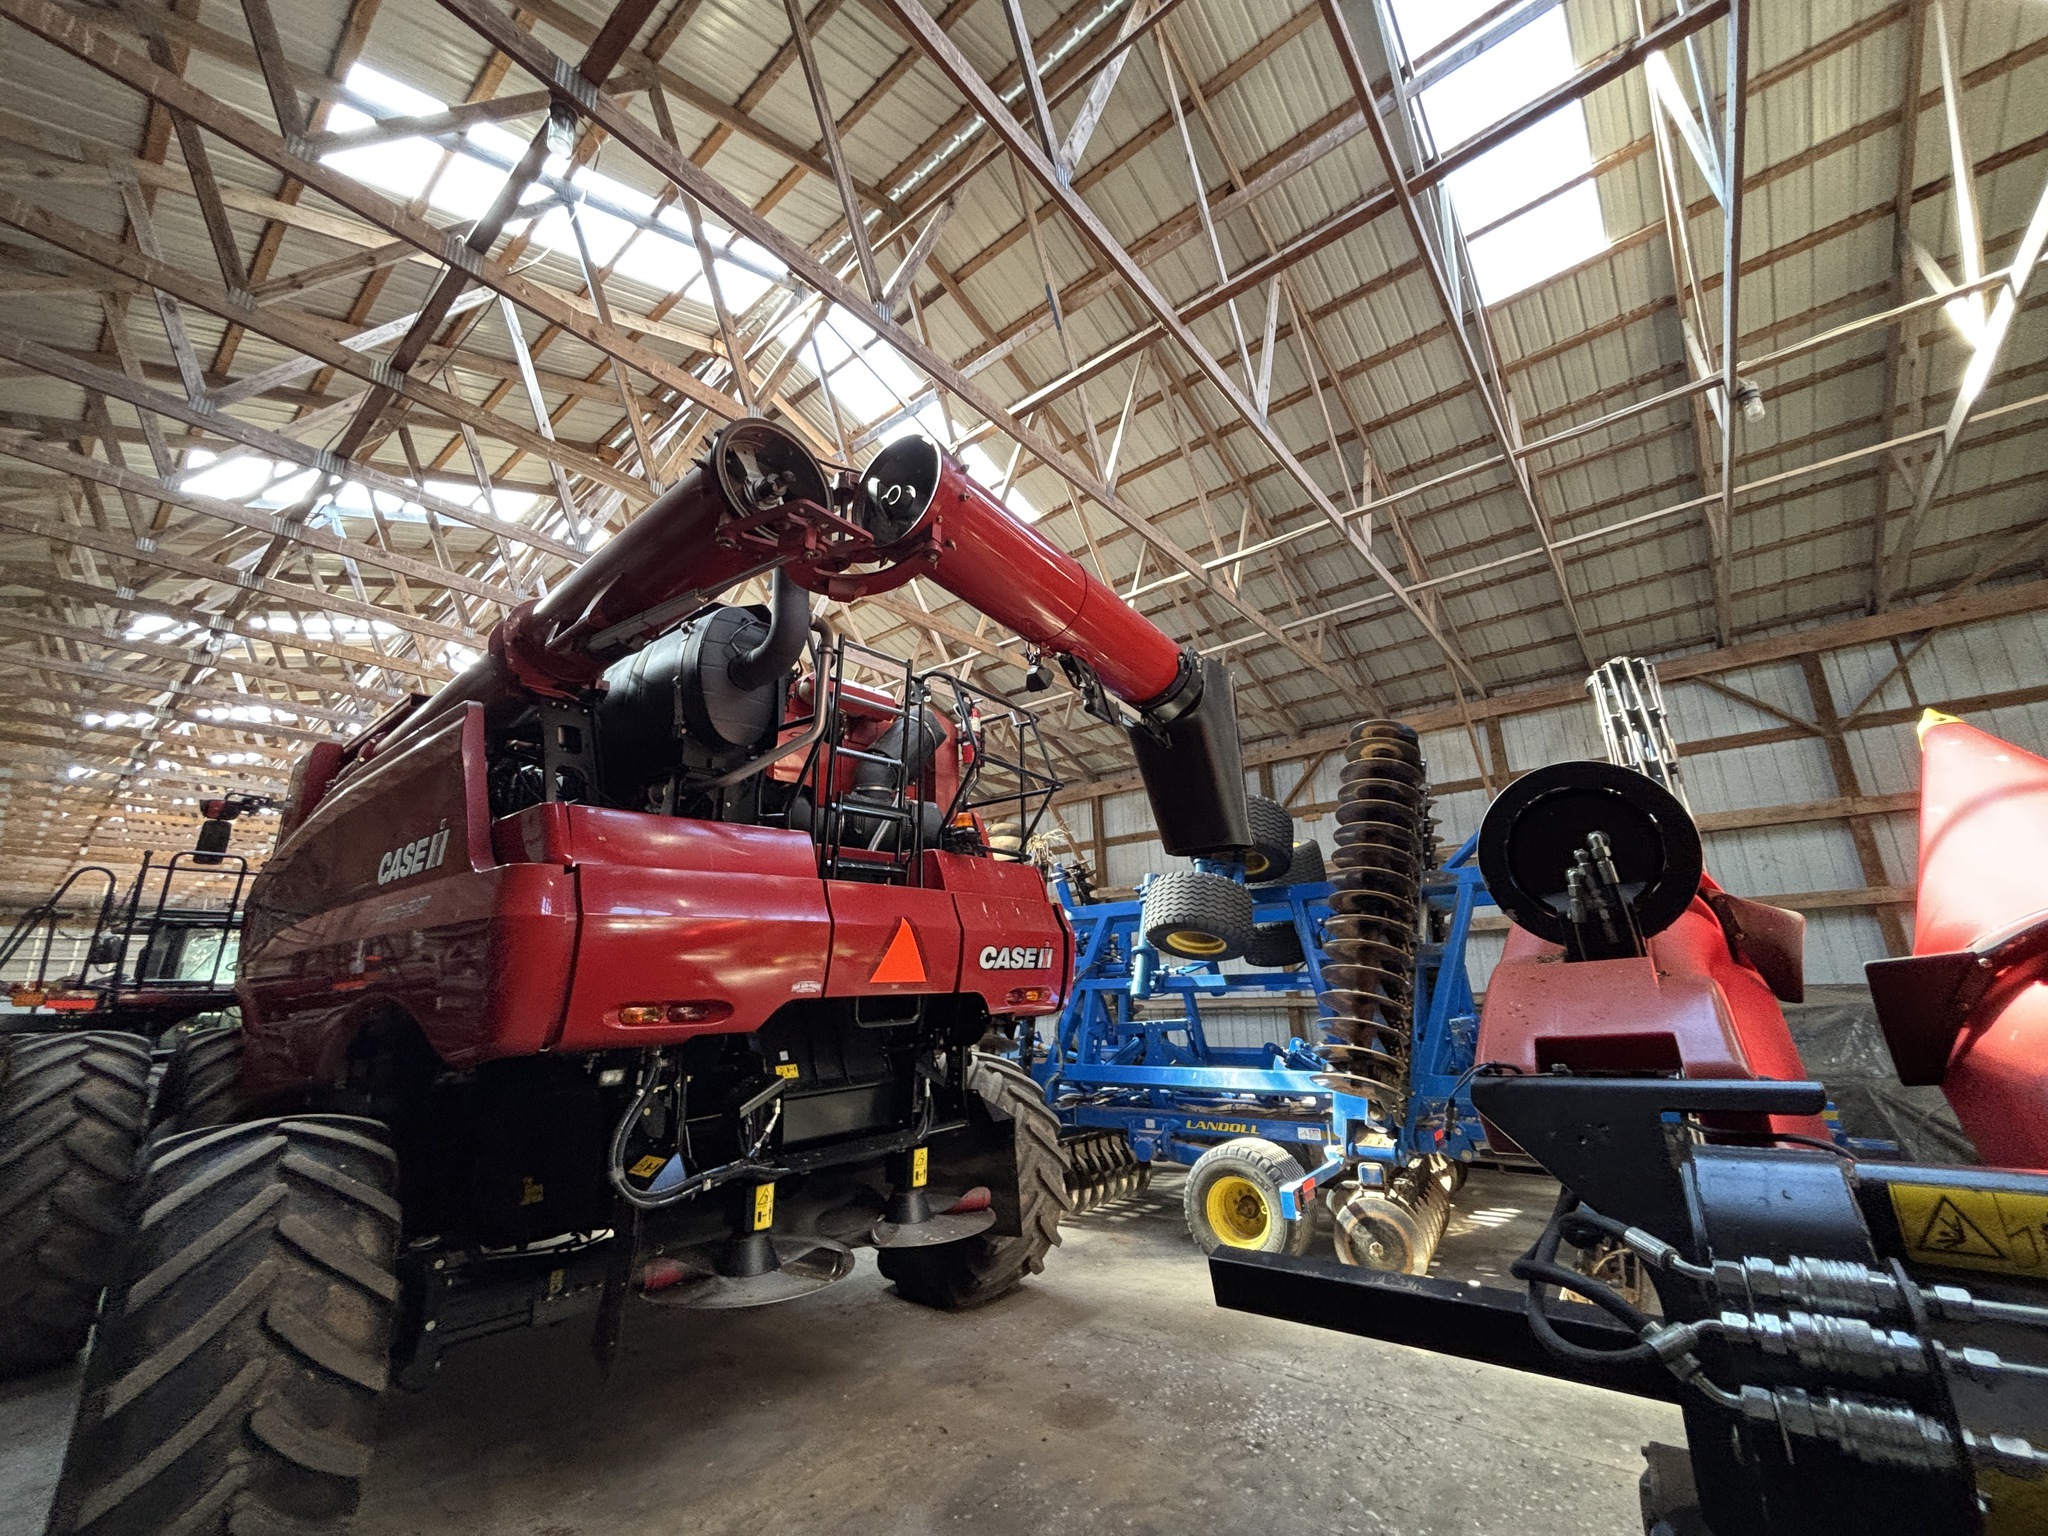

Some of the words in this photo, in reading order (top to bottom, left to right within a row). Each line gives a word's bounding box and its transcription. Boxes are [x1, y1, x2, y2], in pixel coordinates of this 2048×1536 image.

[378, 837, 430, 885] CASE
[979, 946, 1037, 969] CASE
[1185, 1119, 1260, 1135] LANDOLL
